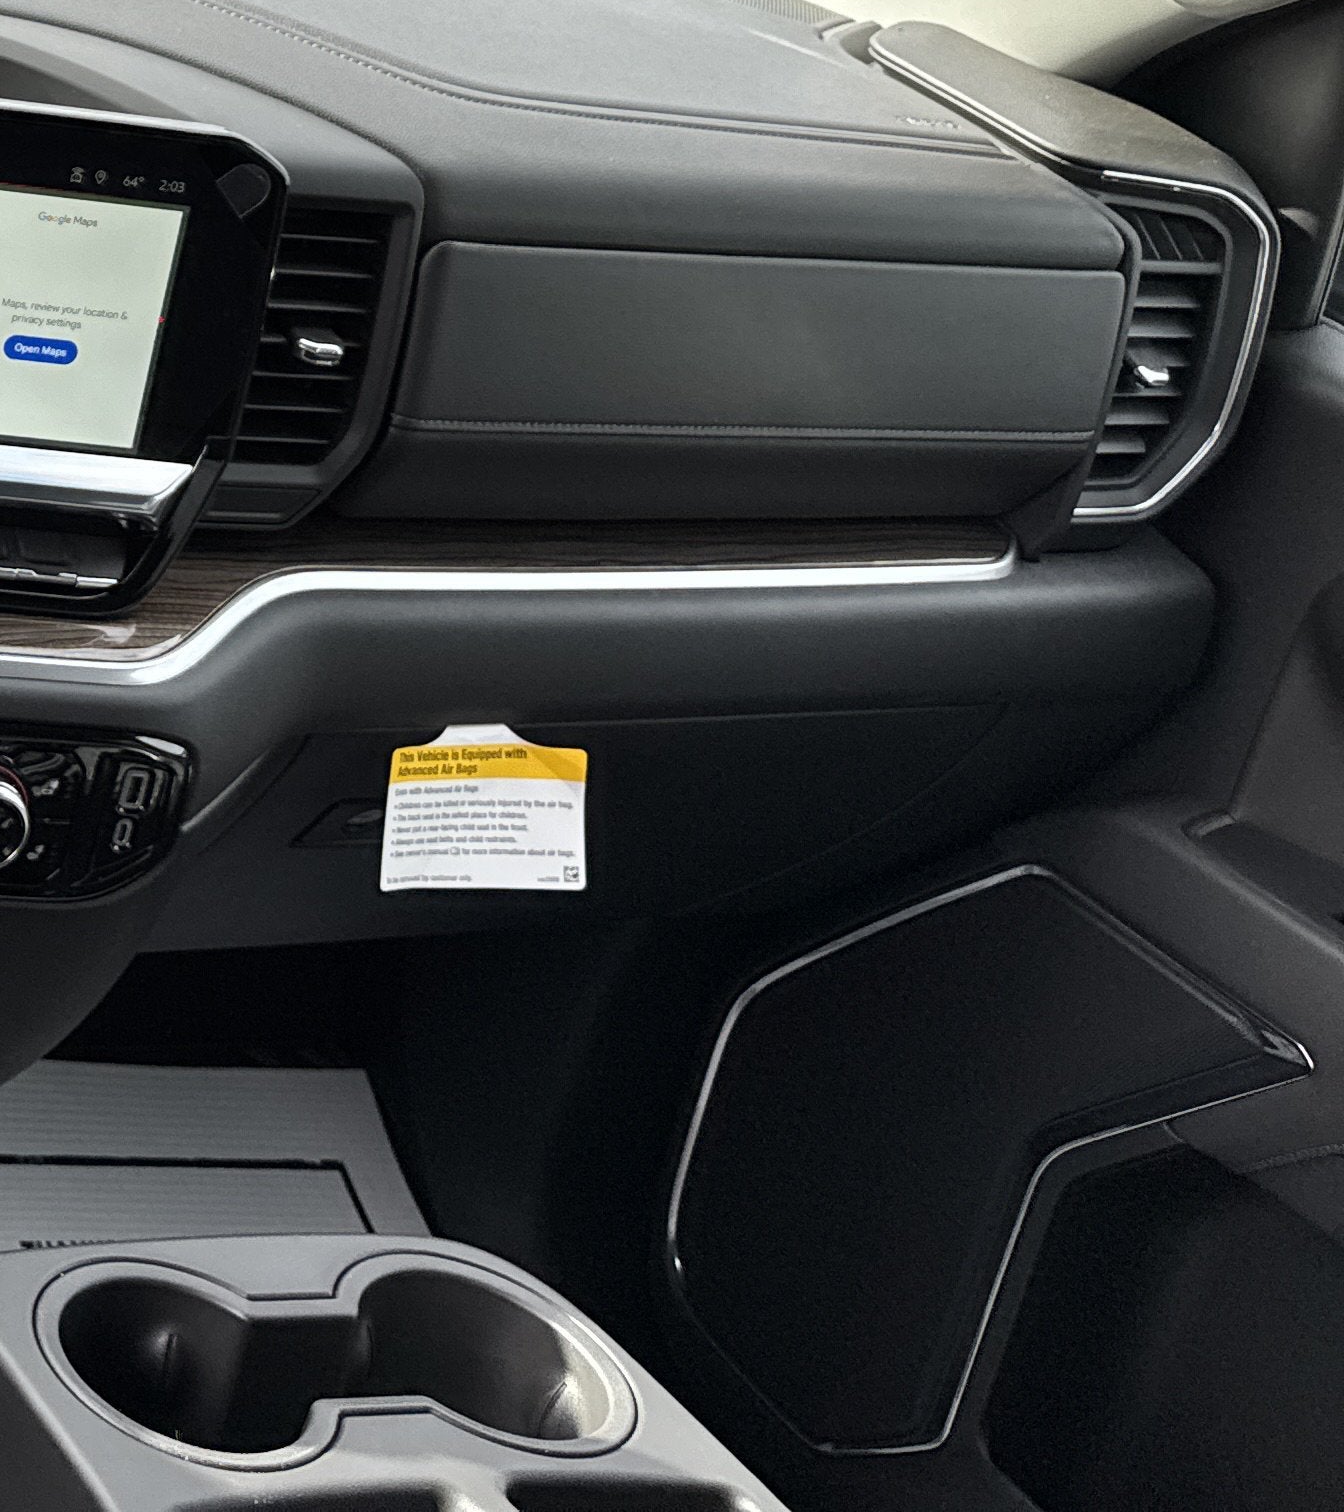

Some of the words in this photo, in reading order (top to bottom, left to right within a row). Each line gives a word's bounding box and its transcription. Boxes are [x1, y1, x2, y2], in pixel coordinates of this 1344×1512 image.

[158, 179, 186, 194] 2:03
[38, 211, 72, 227] Google
[73, 215, 98, 228] Maps
[31, 301, 59, 312] review
[61, 305, 82, 316] your
[83, 306, 118, 320] location
[11, 313, 44, 329] privacy
[45, 316, 82, 330] settings
[14, 342, 39, 355] Open
[40, 346, 67, 359] Maps
[417, 749, 448, 762] Vehicle
[451, 749, 459, 760] is
[461, 748, 502, 762] Equipped
[397, 764, 438, 778] Advanced
[441, 763, 453, 775] Air
[456, 763, 478, 776] Bags
